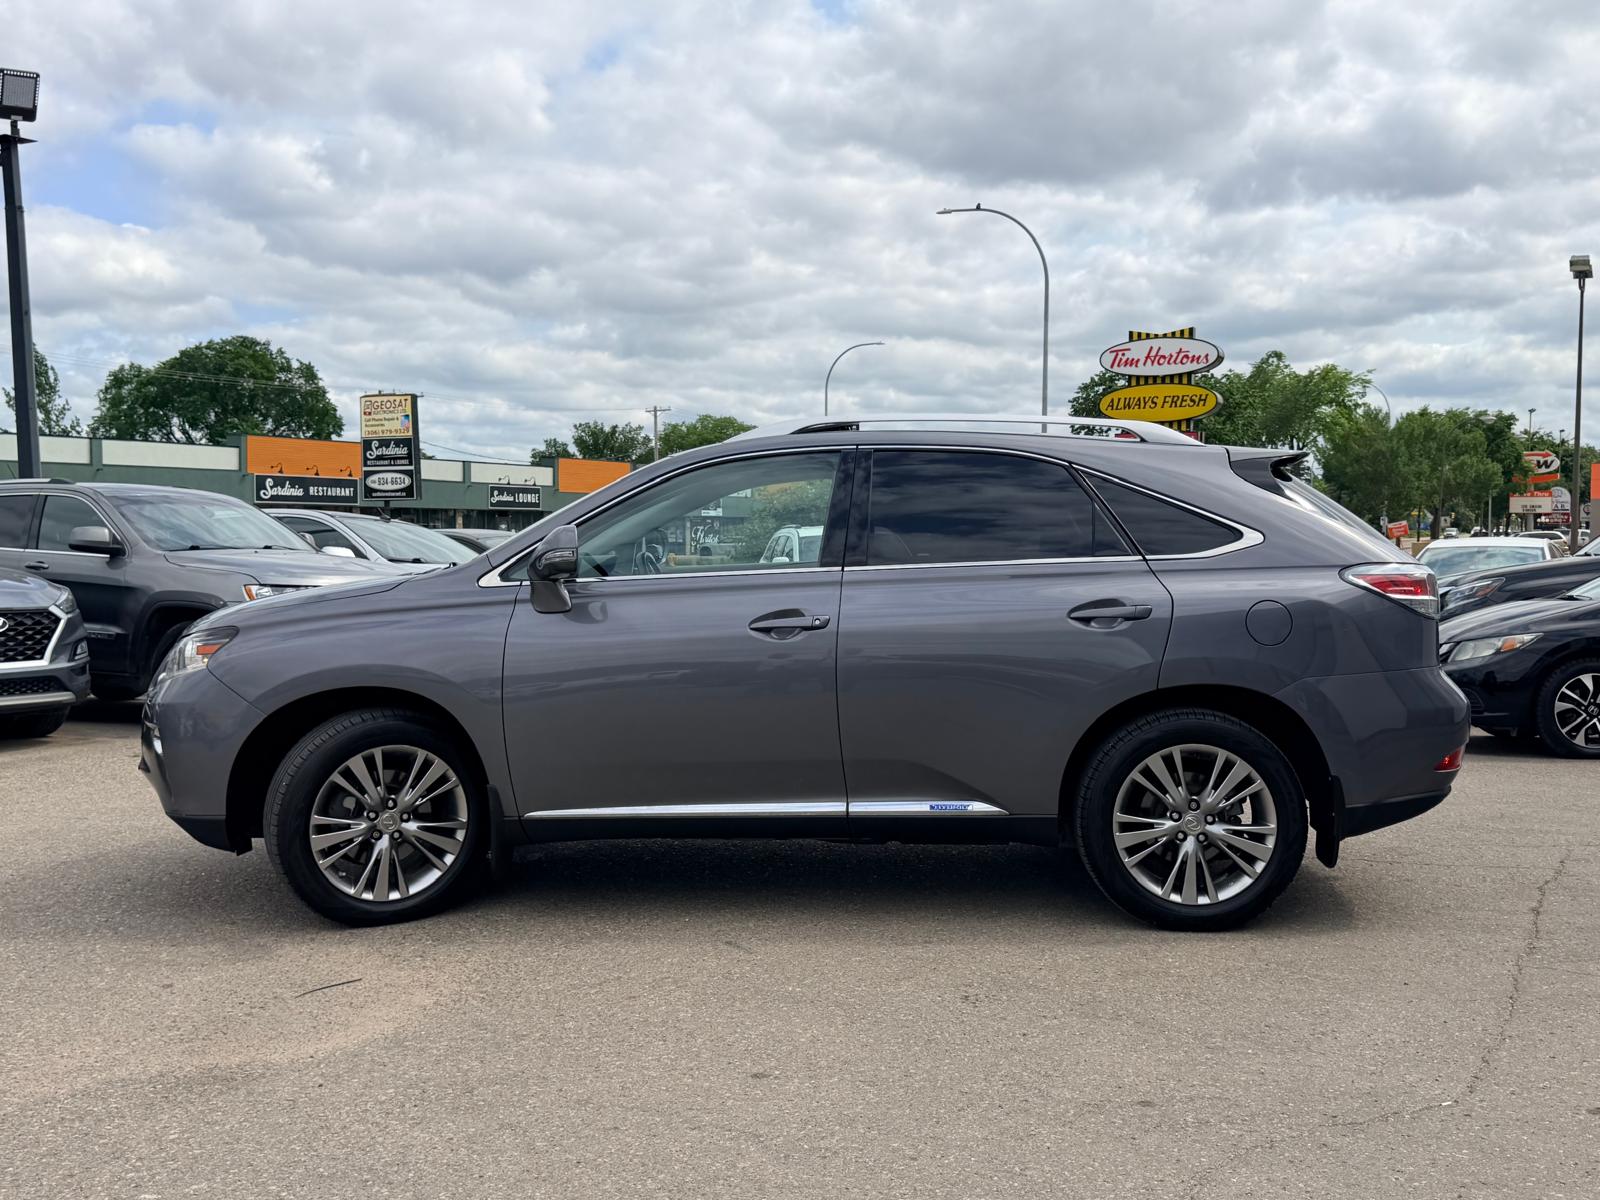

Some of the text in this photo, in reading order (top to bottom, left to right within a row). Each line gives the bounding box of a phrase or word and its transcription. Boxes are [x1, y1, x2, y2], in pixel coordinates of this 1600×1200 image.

[1109, 345, 1209, 369] Tim Hortons
[372, 398, 408, 410] GEOSAT
[1105, 393, 1209, 411] ALWAYS FRESH
[366, 440, 409, 459] Sardinia
[259, 477, 355, 499] Sardinia RESTAURANT
[377, 476, 406, 486] 934-6634
[515, 492, 540, 503] LOUNGE
